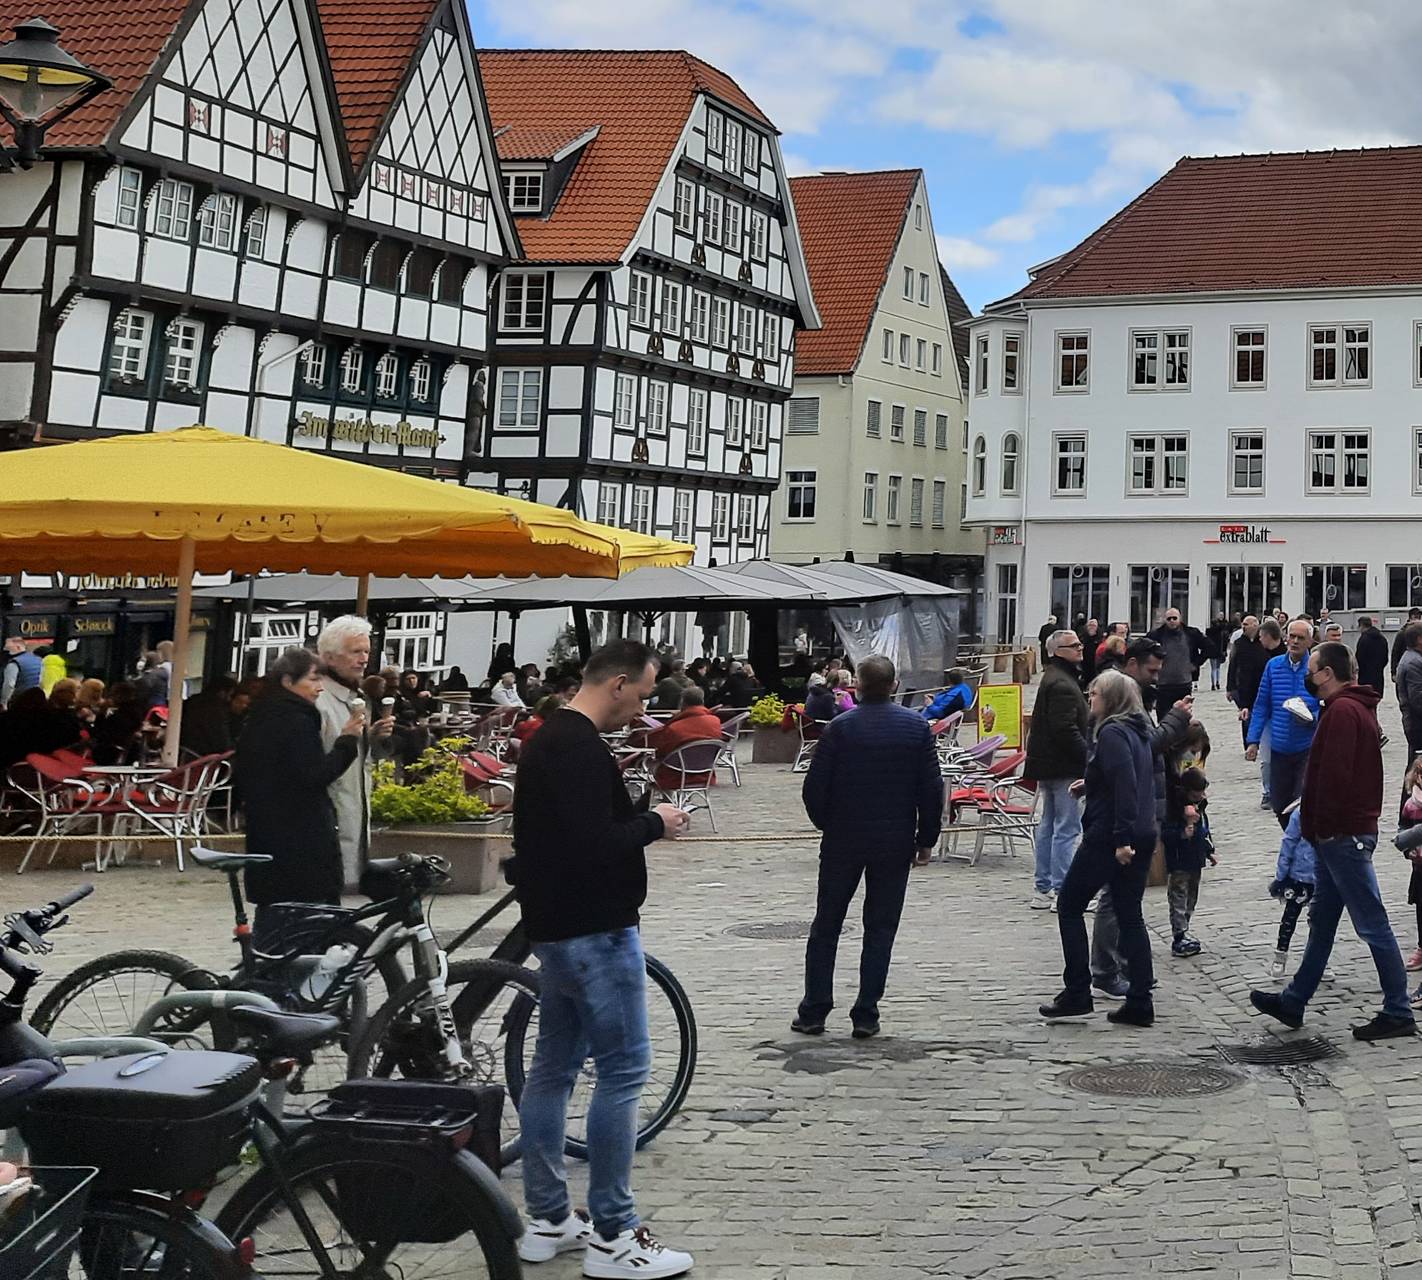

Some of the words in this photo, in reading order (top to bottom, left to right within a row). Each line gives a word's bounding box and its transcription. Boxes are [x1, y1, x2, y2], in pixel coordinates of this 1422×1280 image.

[1220, 526, 1271, 543] extrablatt
[21, 619, 49, 637] Optik
[74, 618, 113, 632] Schmuck
